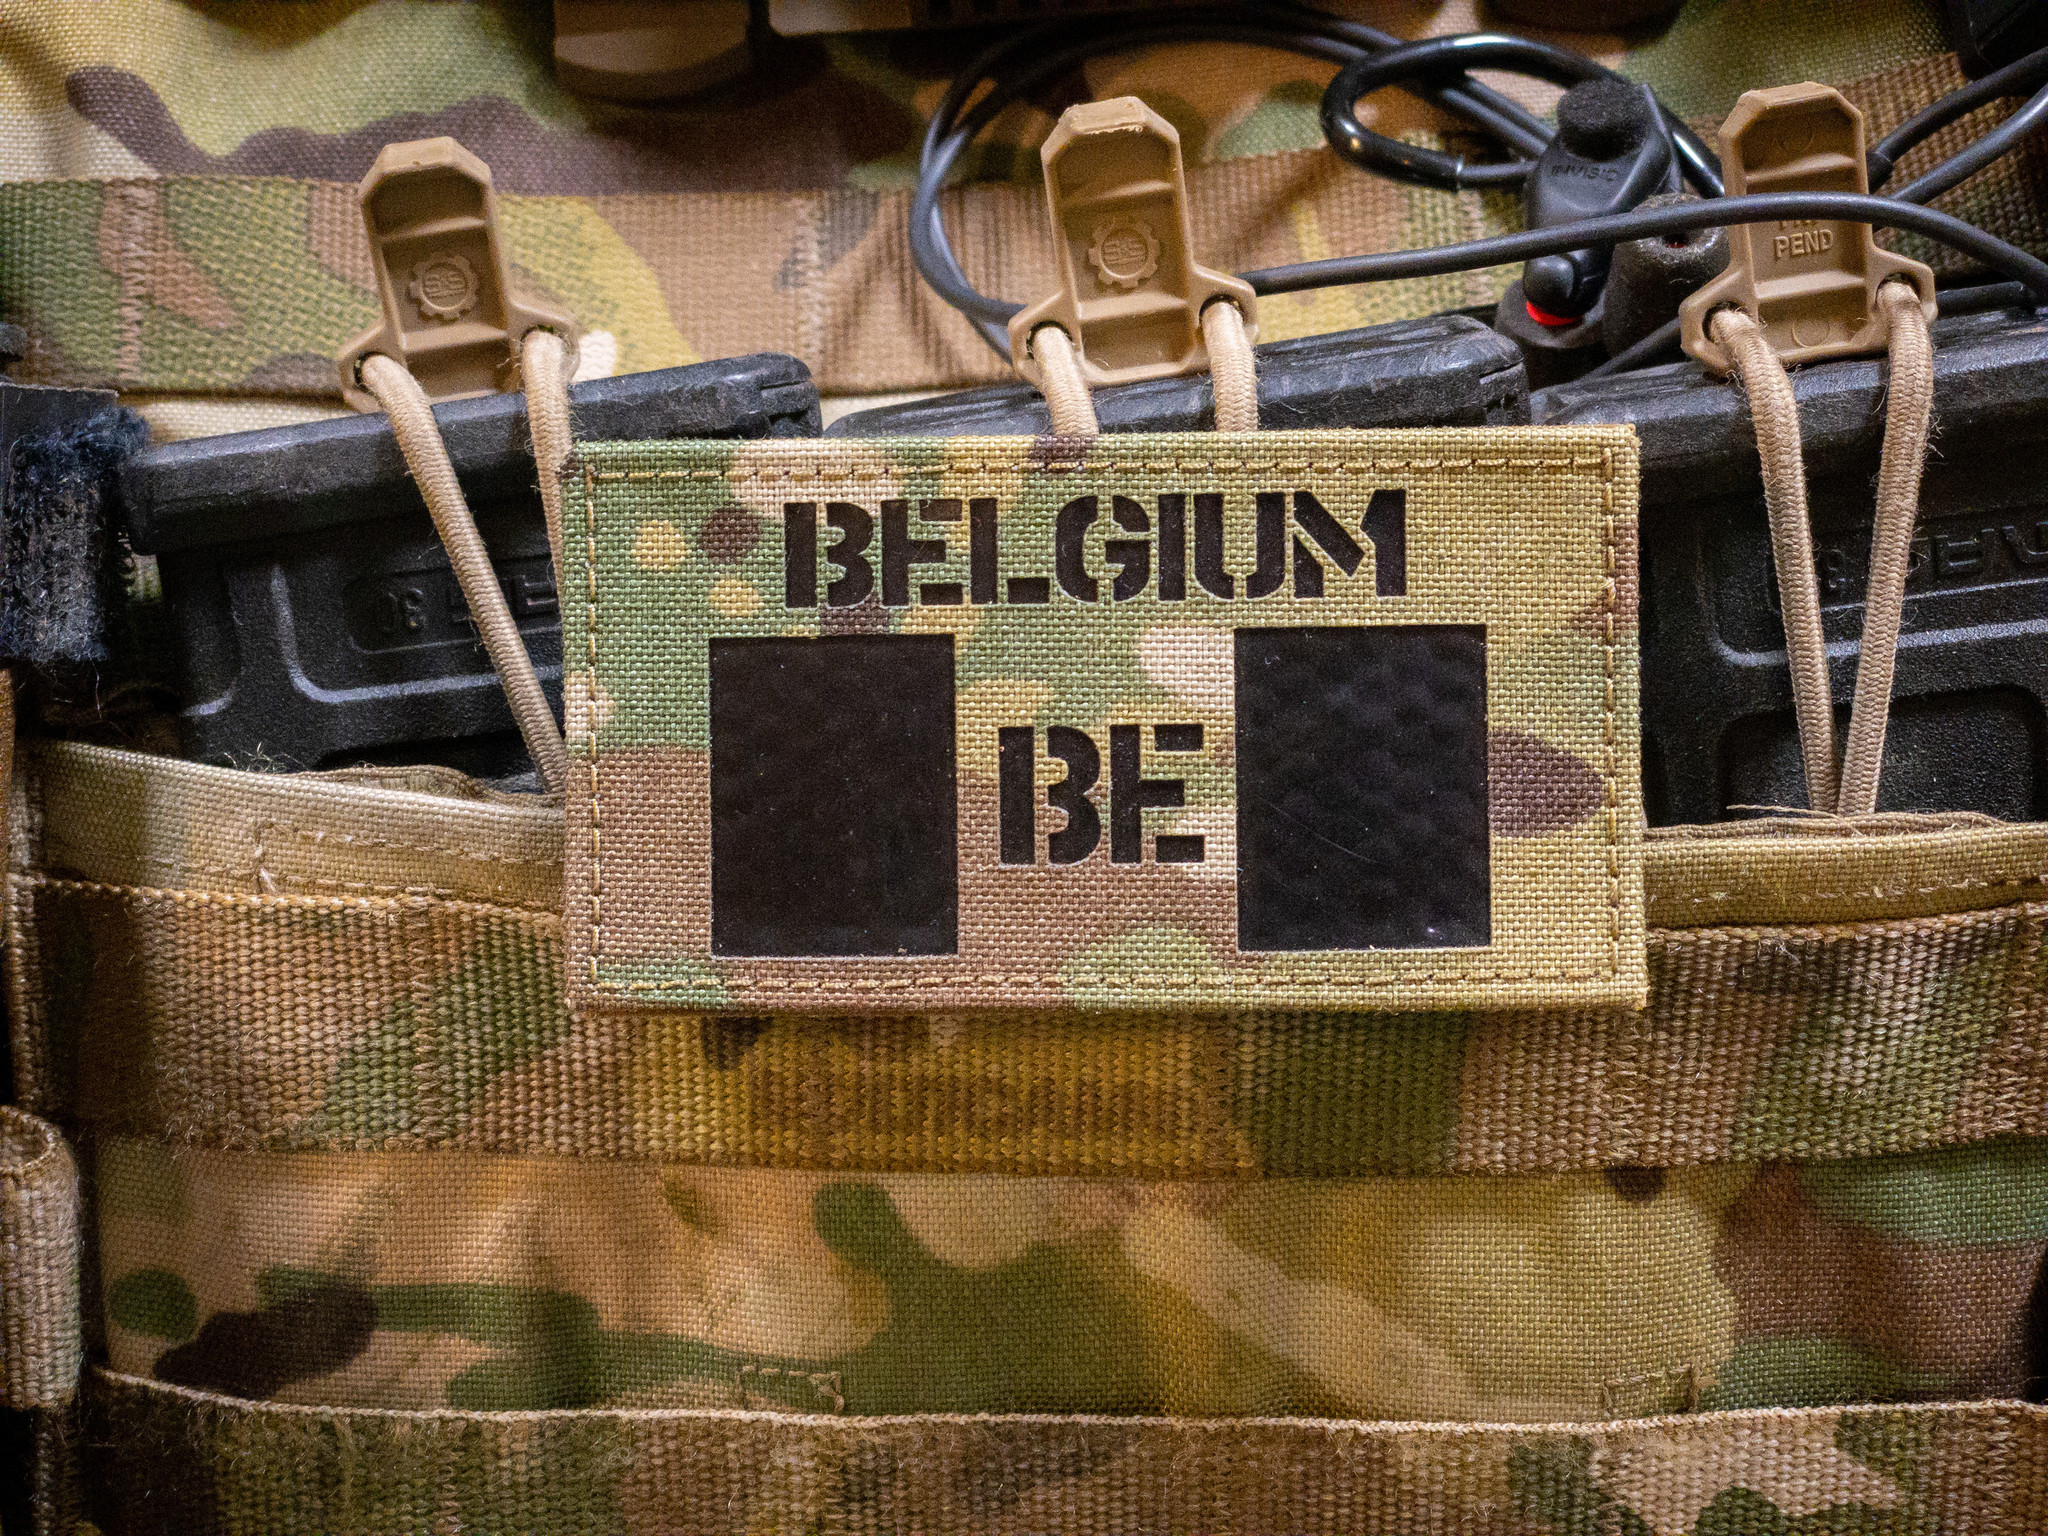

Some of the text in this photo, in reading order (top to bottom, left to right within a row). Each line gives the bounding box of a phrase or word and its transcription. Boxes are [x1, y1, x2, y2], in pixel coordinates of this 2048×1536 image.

[1773, 229, 1834, 260] PEND
[783, 489, 1407, 607] BELGIUM
[999, 723, 1205, 867] BE
